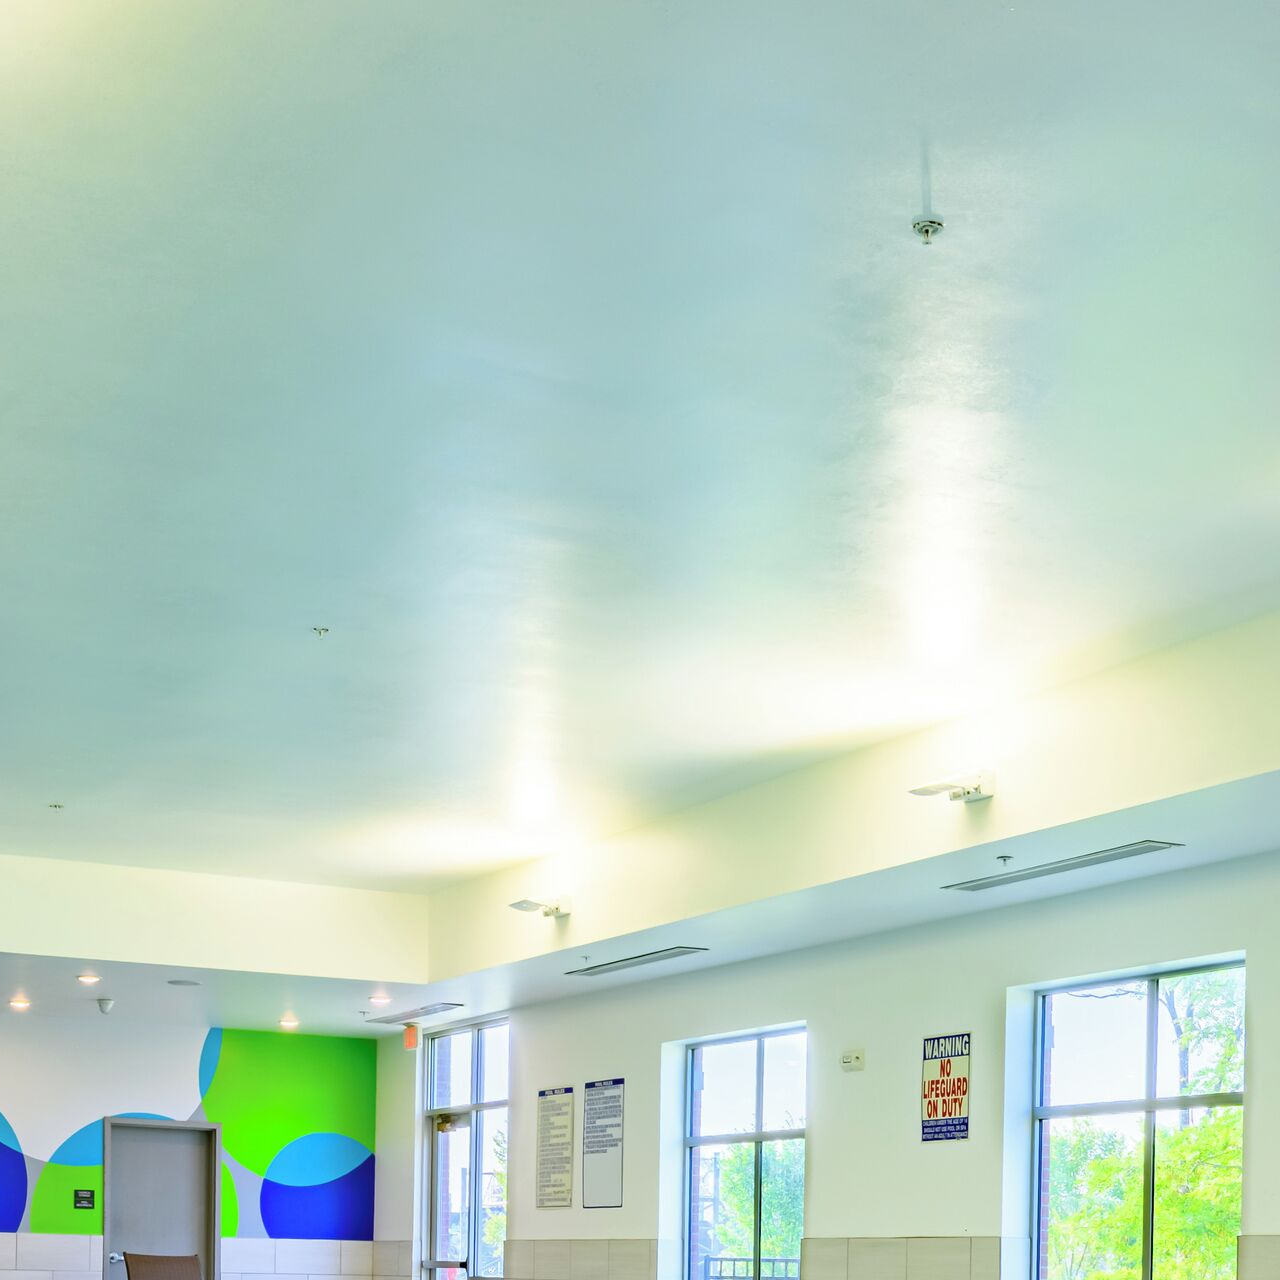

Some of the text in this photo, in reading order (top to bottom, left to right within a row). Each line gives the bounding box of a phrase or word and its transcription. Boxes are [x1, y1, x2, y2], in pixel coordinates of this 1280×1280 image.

[924, 1034, 969, 1059] WARNING
[939, 1058, 952, 1078] NO
[923, 1077, 968, 1099] LIFEGUARD
[927, 1097, 964, 1119] ON DUTY
